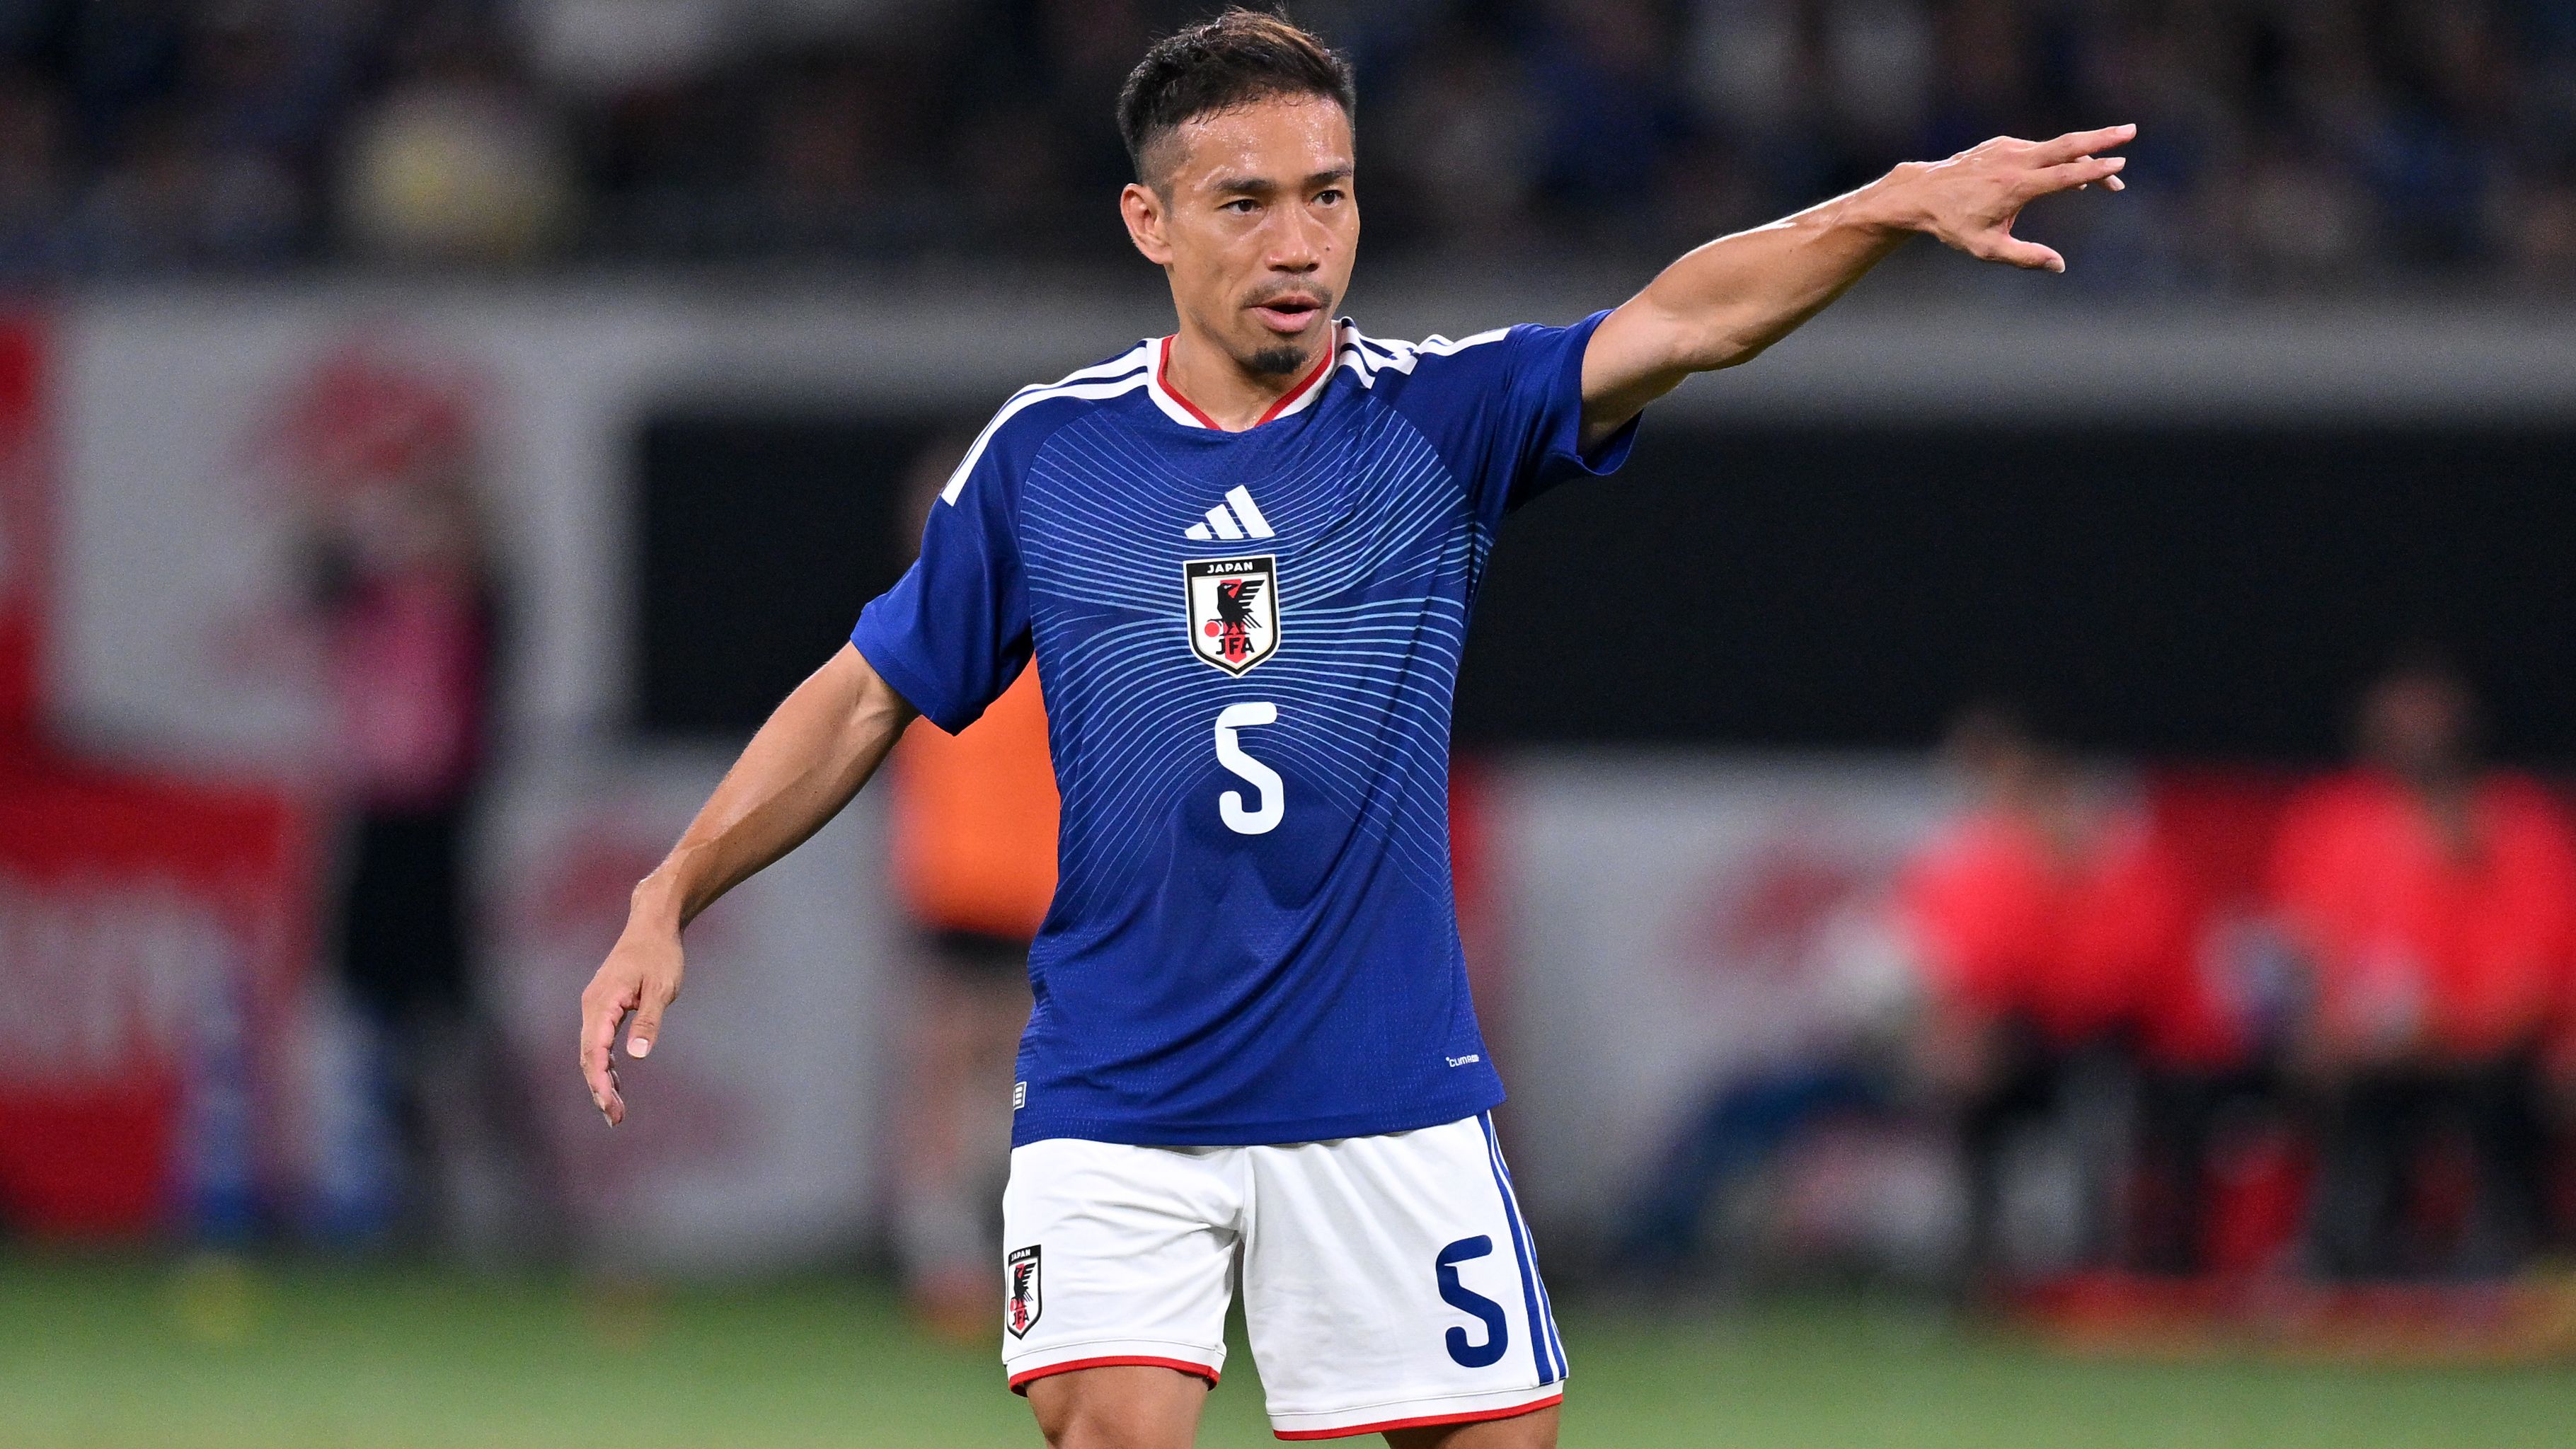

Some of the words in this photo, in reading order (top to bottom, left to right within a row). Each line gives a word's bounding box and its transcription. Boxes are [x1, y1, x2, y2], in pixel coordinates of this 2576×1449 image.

[1207, 562, 1253, 574] JAPAN
[1216, 637, 1255, 655] JFA
[1214, 702, 1284, 835] 5
[1011, 1249, 1030, 1262] JAPAN
[1436, 1235, 1508, 1368] 5
[1012, 1309, 1030, 1326] JFA
